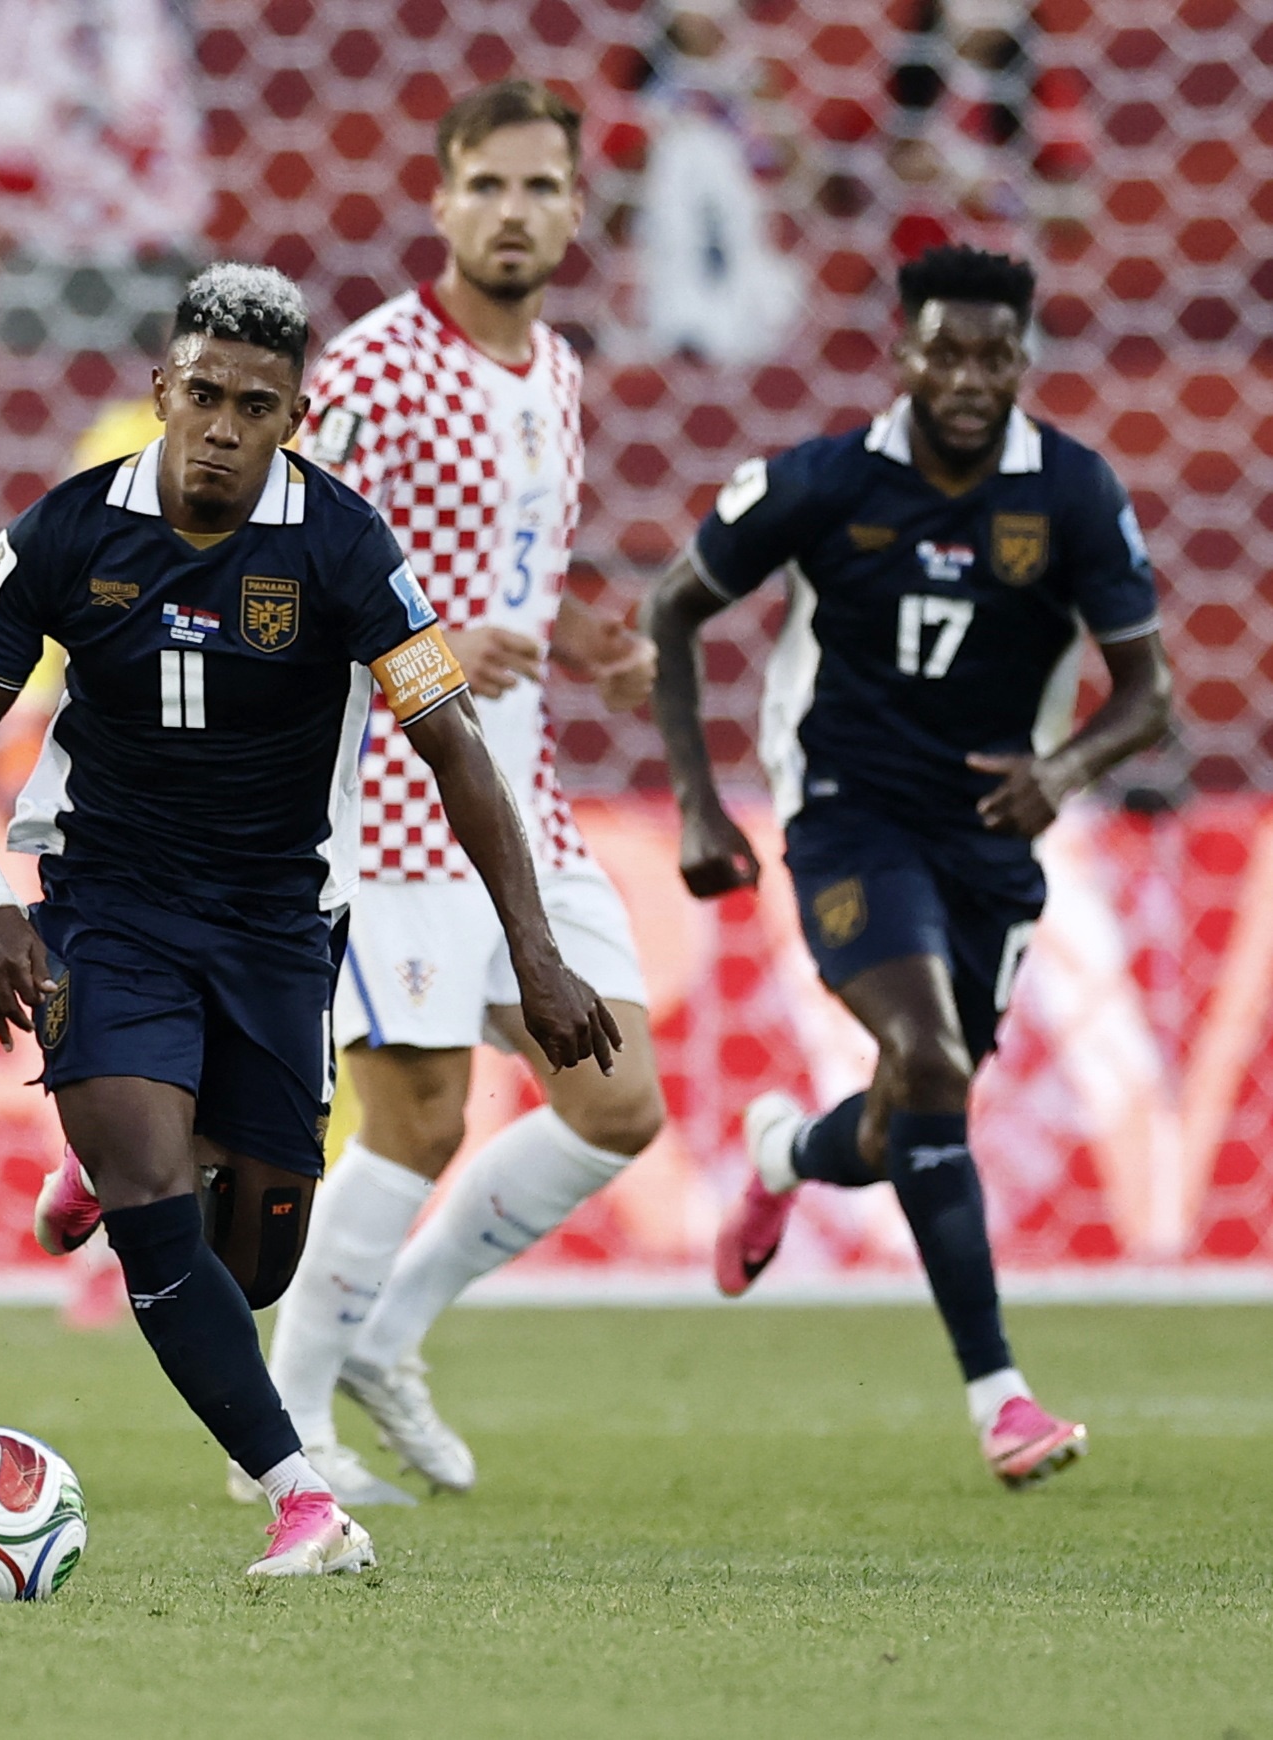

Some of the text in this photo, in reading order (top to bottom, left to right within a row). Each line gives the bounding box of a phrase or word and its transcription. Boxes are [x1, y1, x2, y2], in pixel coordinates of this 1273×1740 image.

[247, 581, 294, 593] PANAMA
[503, 530, 535, 608] 3
[384, 636, 436, 673] FOOTBALL
[896, 594, 975, 679] 17
[390, 646, 443, 688] UNITES
[395, 660, 451, 703] the World
[160, 649, 206, 729] 11
[421, 686, 440, 701] FIFA
